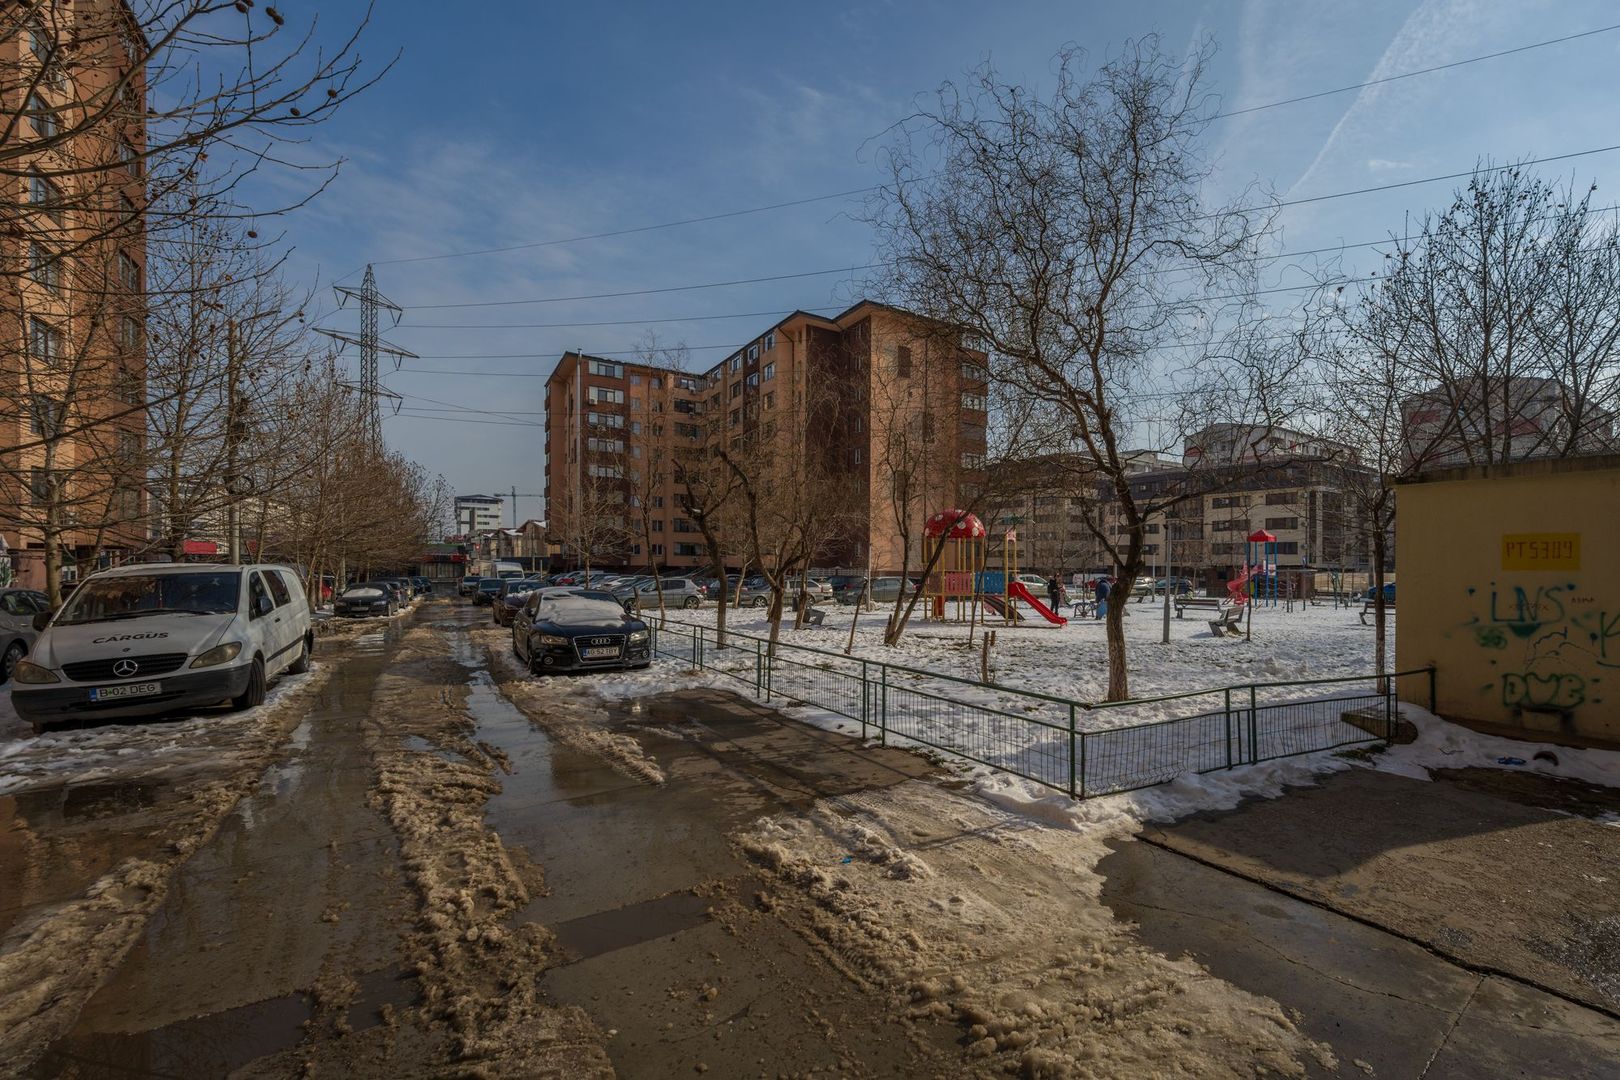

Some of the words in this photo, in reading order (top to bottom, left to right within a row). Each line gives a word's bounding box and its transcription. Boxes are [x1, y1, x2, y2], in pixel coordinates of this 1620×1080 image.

[92, 632, 169, 644] CARGUS
[99, 688, 108, 697] B
[113, 687, 126, 696] 02
[130, 684, 155, 694] DEG
